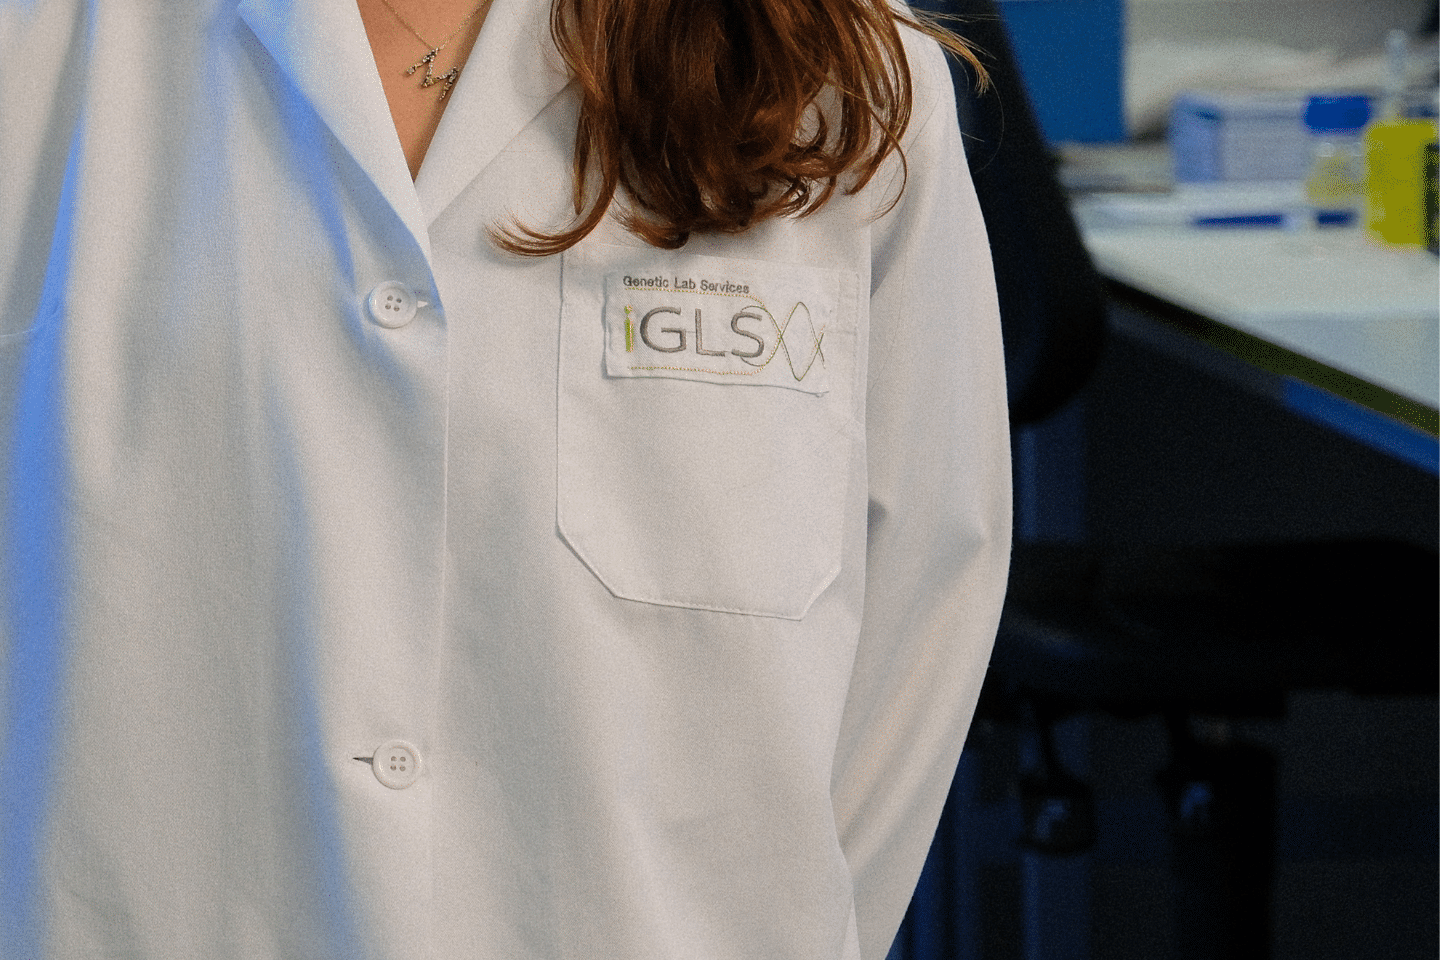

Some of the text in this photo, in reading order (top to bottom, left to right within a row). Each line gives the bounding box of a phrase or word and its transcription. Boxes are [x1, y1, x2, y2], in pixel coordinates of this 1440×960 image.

[623, 275, 750, 294] Genetic Lab Services
